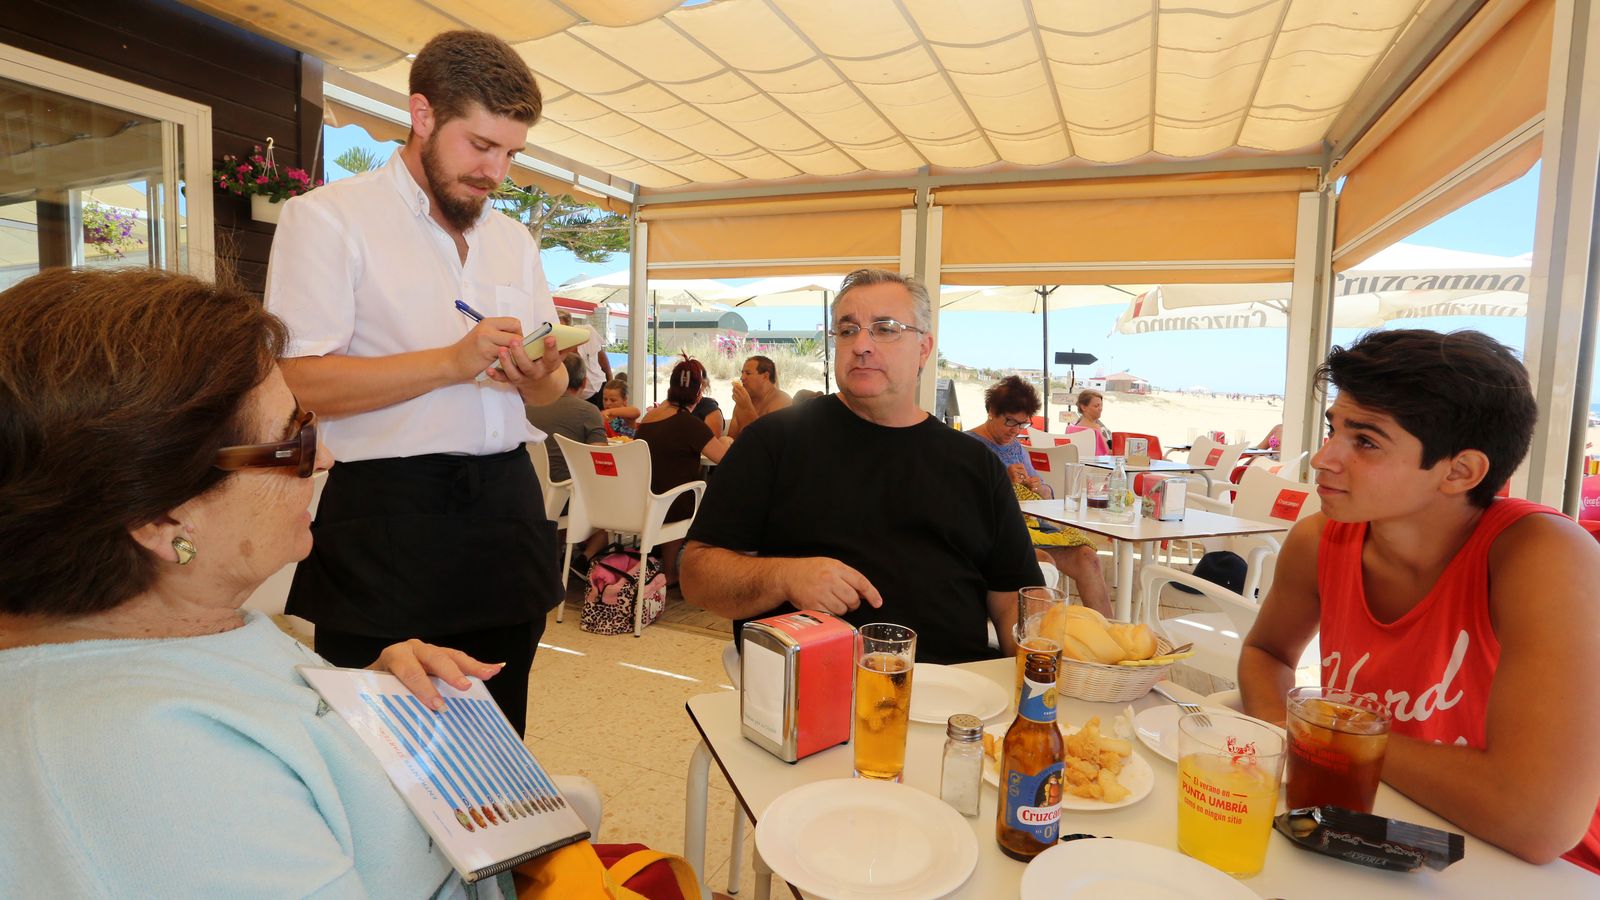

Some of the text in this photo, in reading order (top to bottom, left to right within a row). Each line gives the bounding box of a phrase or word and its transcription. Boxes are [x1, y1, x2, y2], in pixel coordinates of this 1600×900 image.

[1182, 780, 1249, 814] PUNTA UMBRÍA
[1200, 781, 1221, 796] verano
